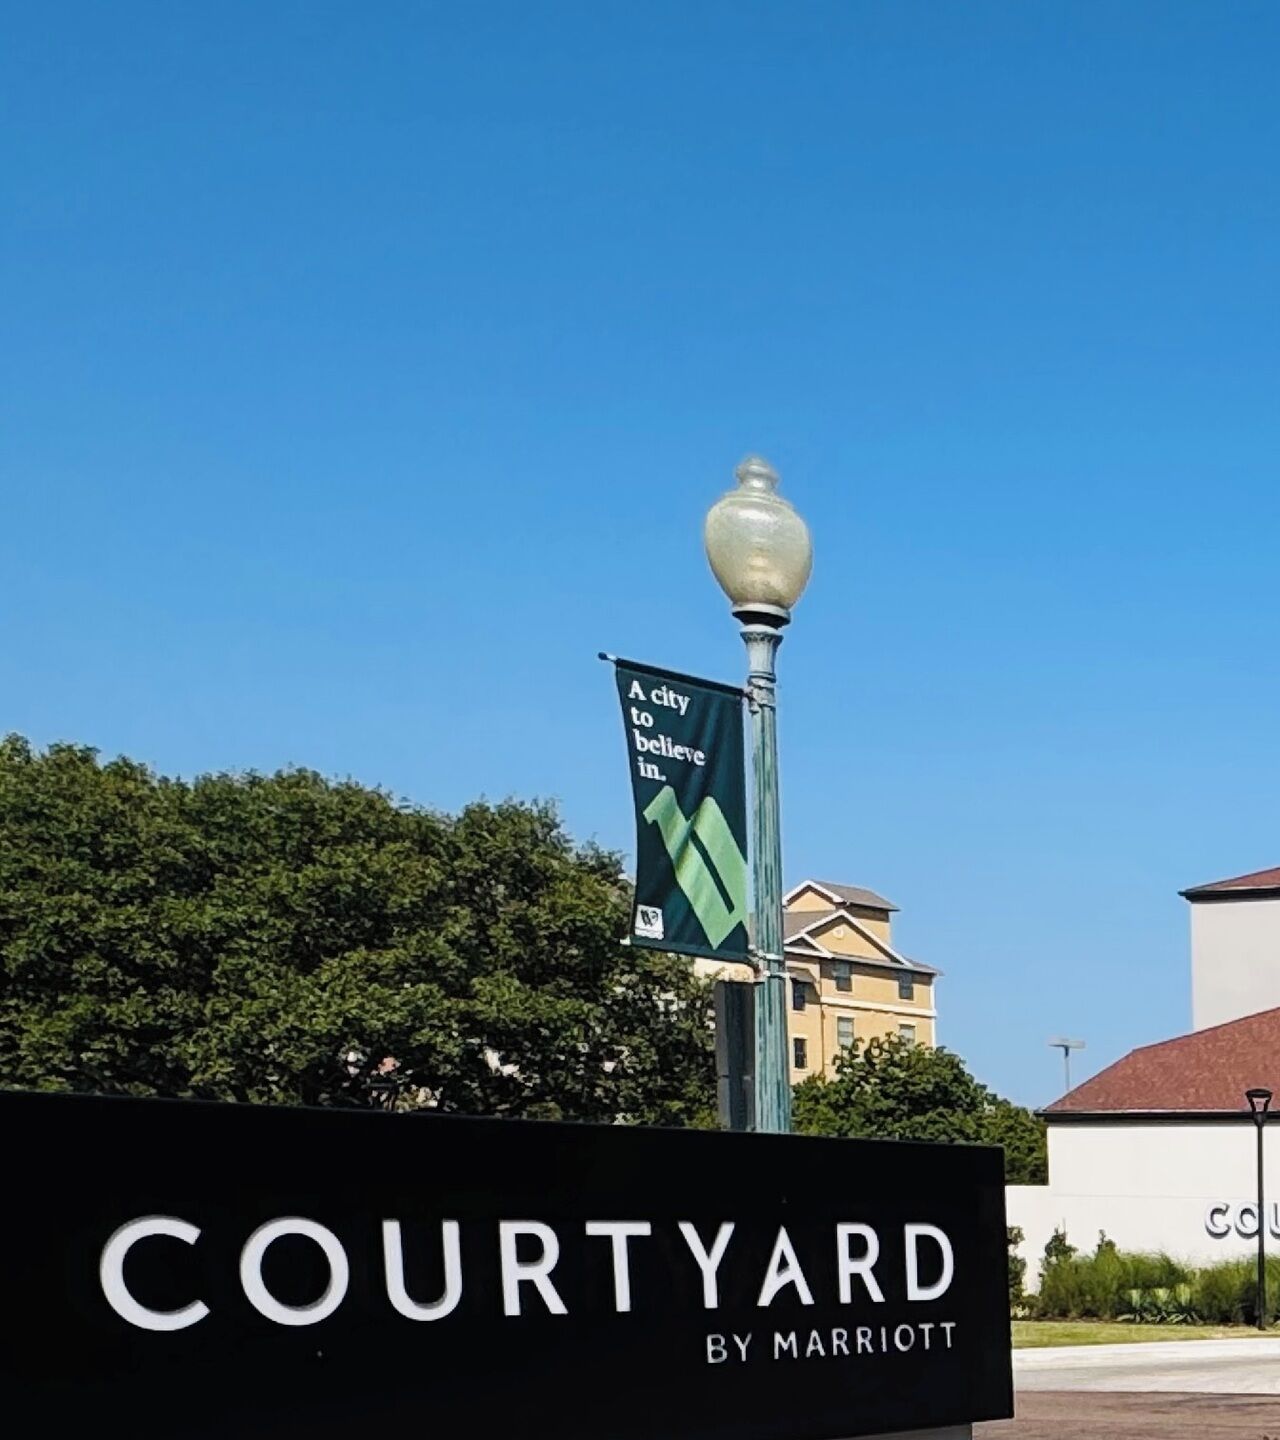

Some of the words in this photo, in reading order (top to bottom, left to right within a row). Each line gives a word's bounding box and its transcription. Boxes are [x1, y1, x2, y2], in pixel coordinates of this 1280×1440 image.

[628, 680, 647, 700] A
[651, 685, 690, 715] city
[631, 707, 653, 727] to
[633, 729, 705, 766] believe
[637, 756, 666, 781] in.
[99, 1217, 956, 1331] COURTYARD
[707, 1333, 752, 1364] BY
[774, 1322, 957, 1360] MARRIOTT
